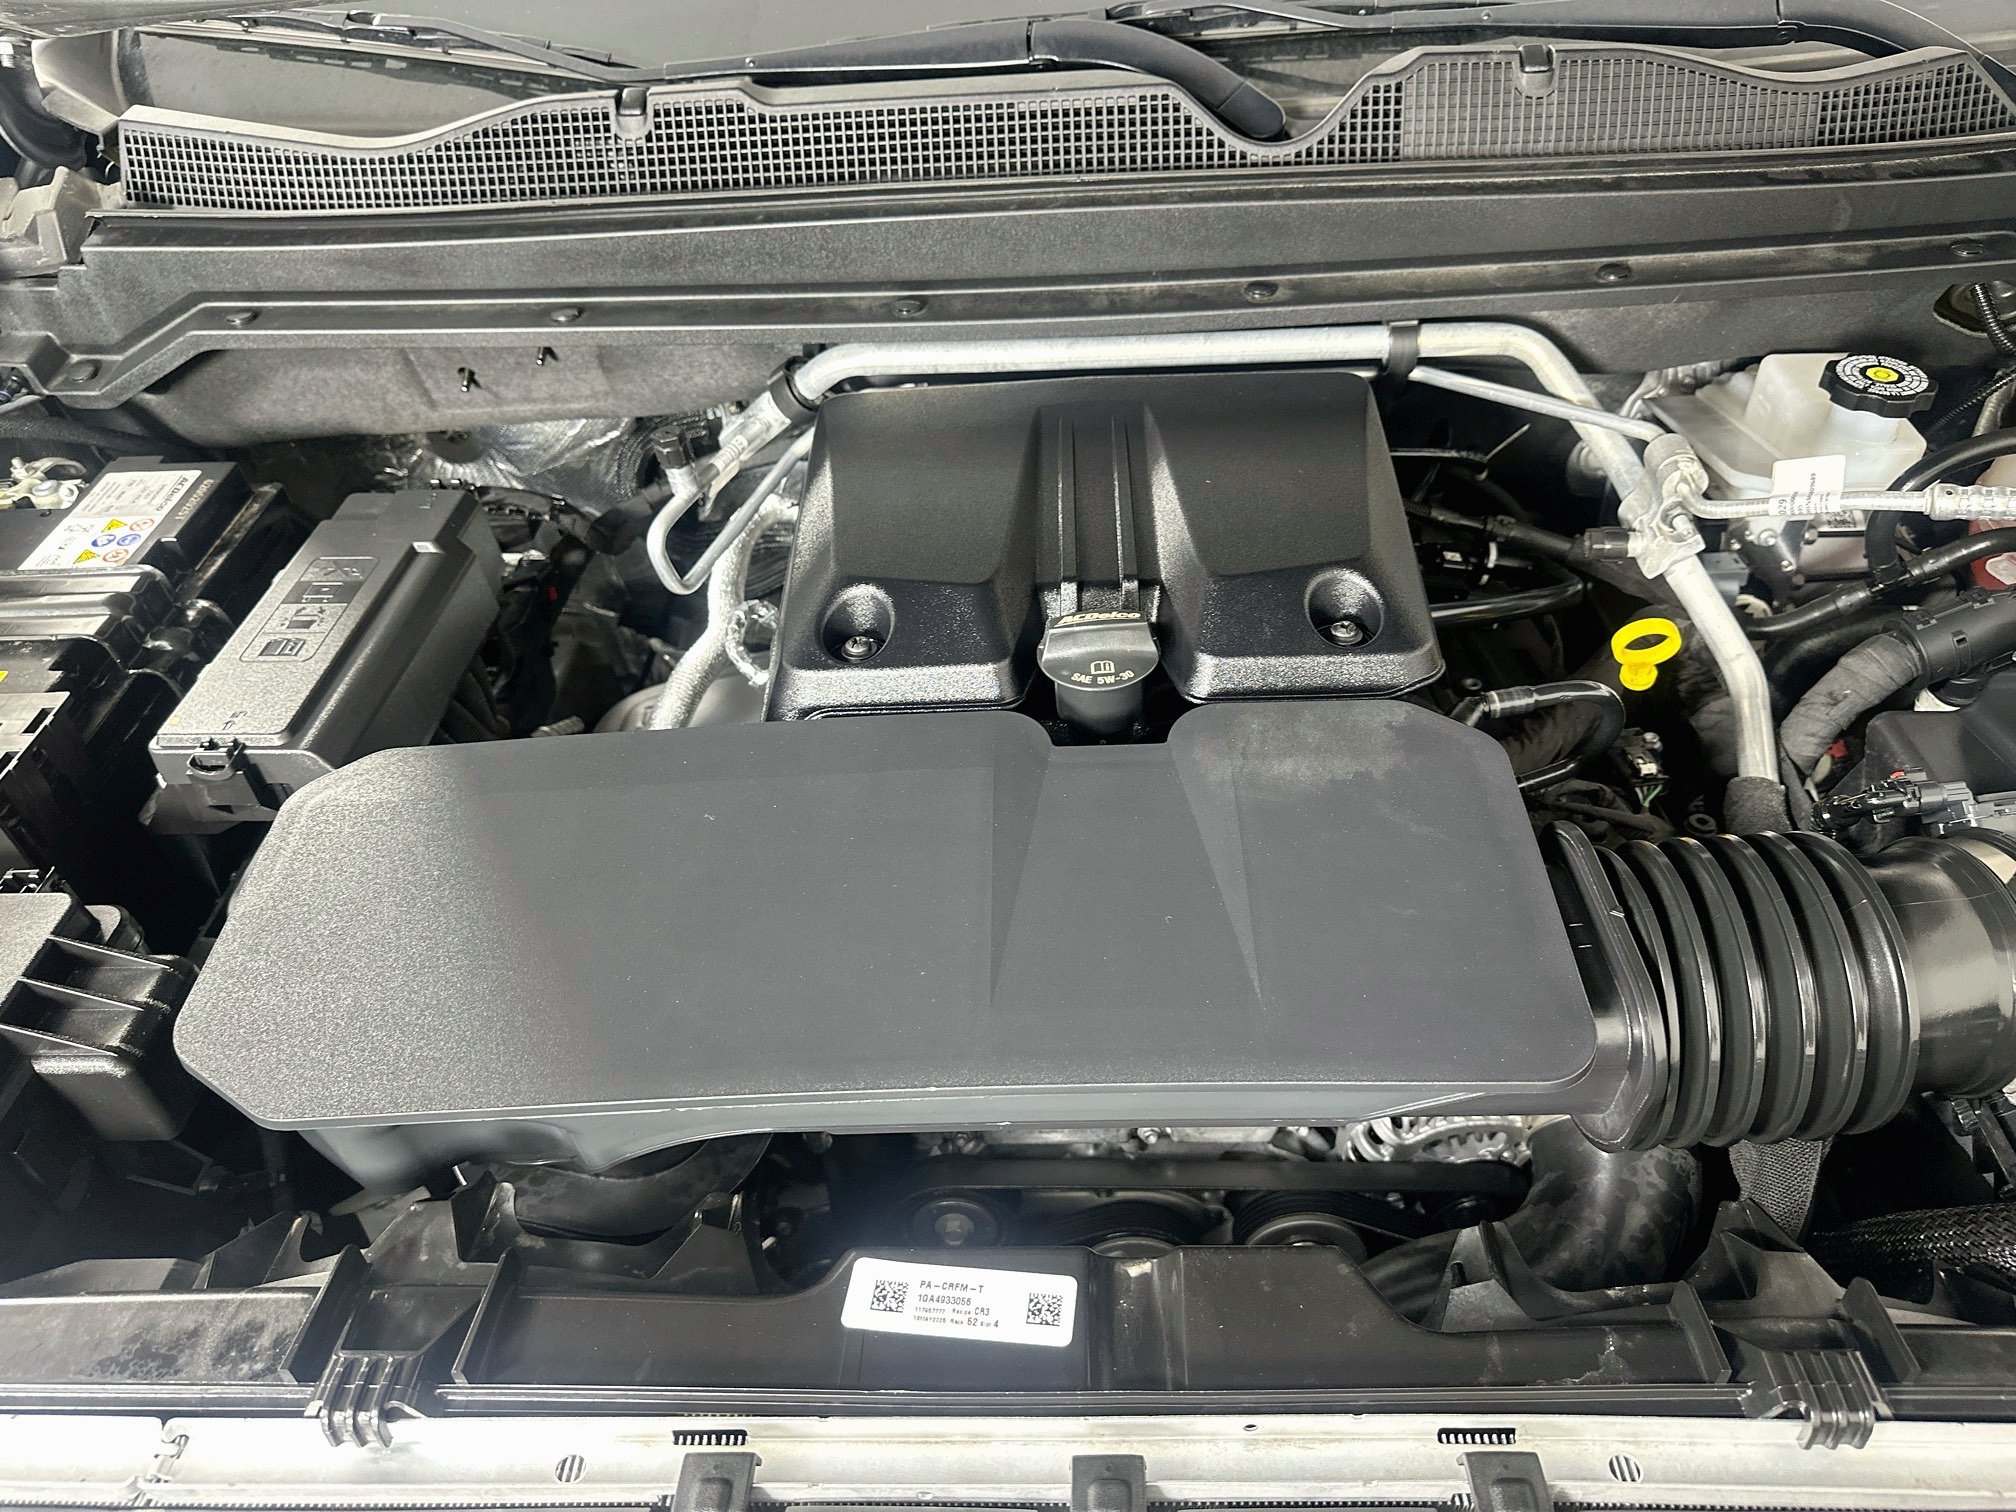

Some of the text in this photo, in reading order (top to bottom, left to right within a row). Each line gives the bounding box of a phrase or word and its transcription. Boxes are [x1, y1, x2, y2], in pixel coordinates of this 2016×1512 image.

[1053, 611, 1141, 628] ACDelco
[1071, 670, 1135, 685] SAE 5W-30
[974, 1306, 990, 1316] CR3
[993, 1319, 999, 1328] 4
